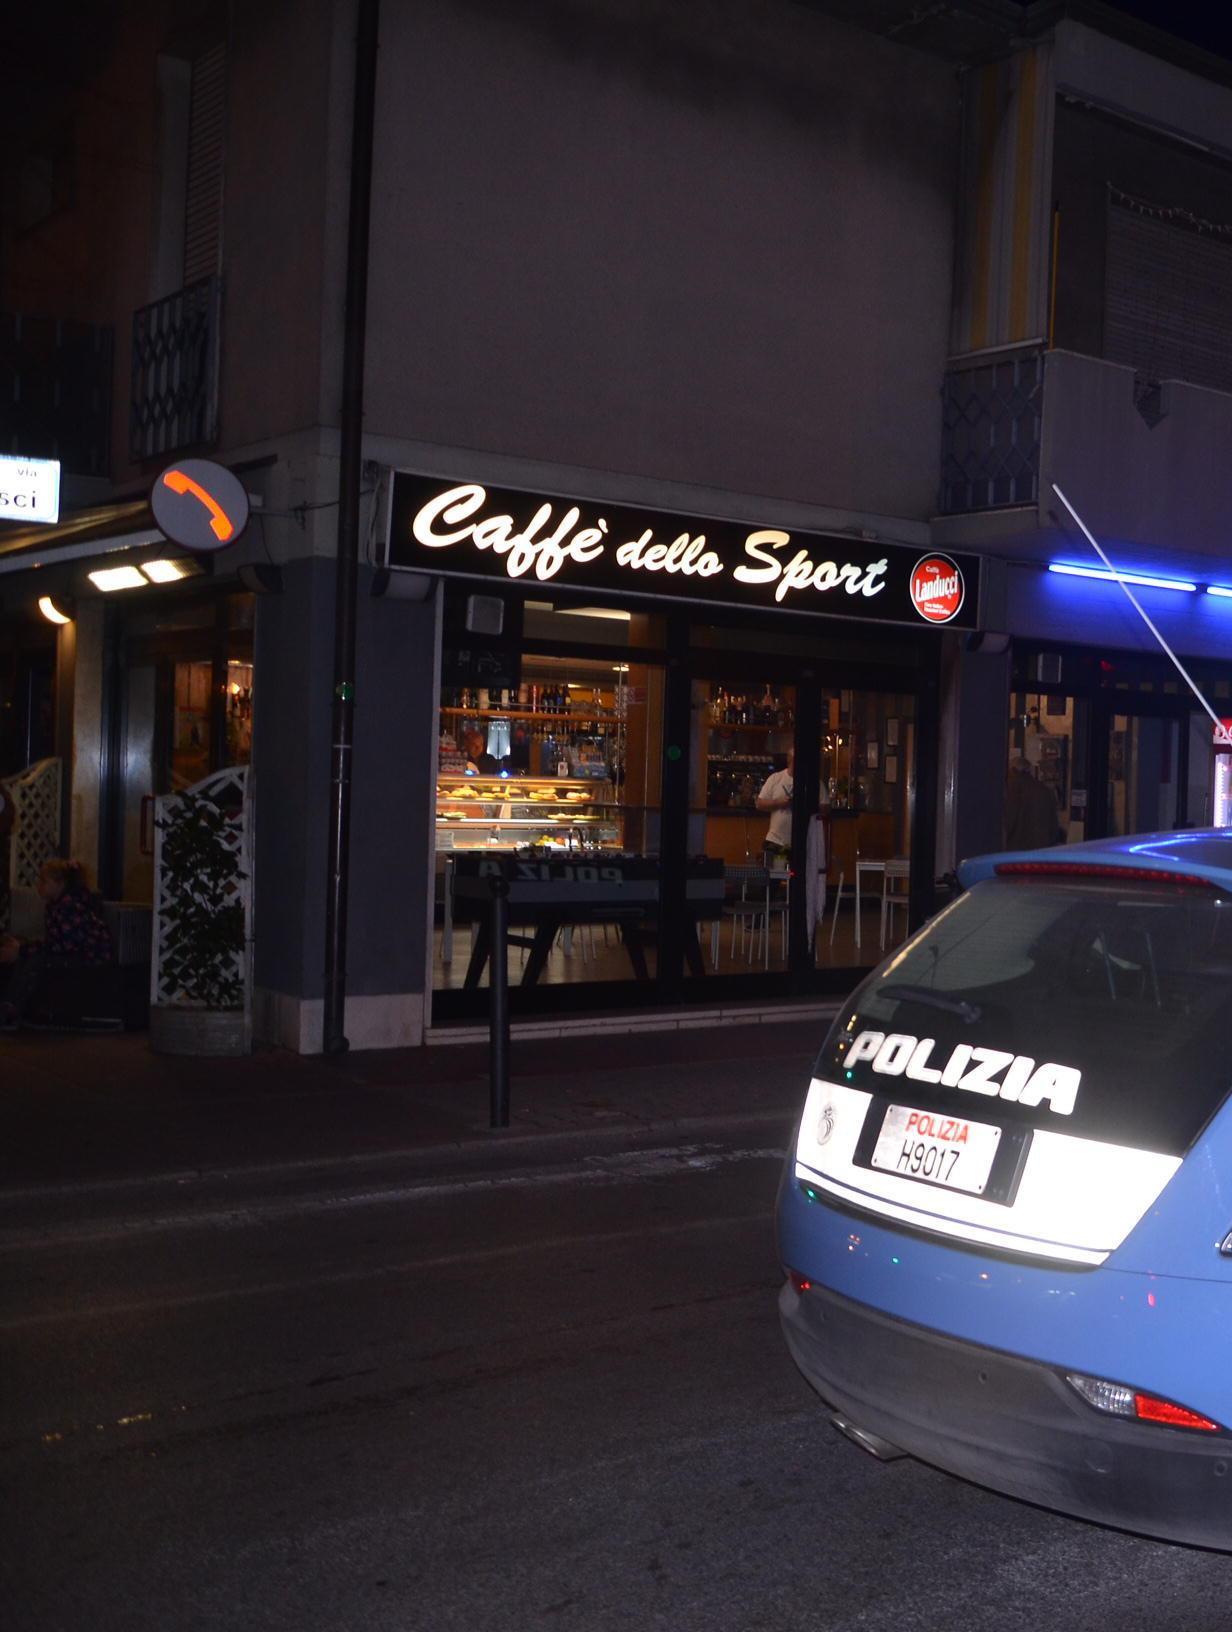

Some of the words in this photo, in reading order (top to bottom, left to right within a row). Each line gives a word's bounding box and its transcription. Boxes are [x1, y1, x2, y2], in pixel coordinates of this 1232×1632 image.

[412, 484, 609, 581] Caffè
[616, 528, 724, 577] dello
[733, 530, 888, 602] Sport
[915, 569, 959, 603] Landucci
[843, 1031, 1081, 1115] POLIZIA
[905, 1112, 969, 1145] POLIZIA
[896, 1139, 960, 1181] H9017
